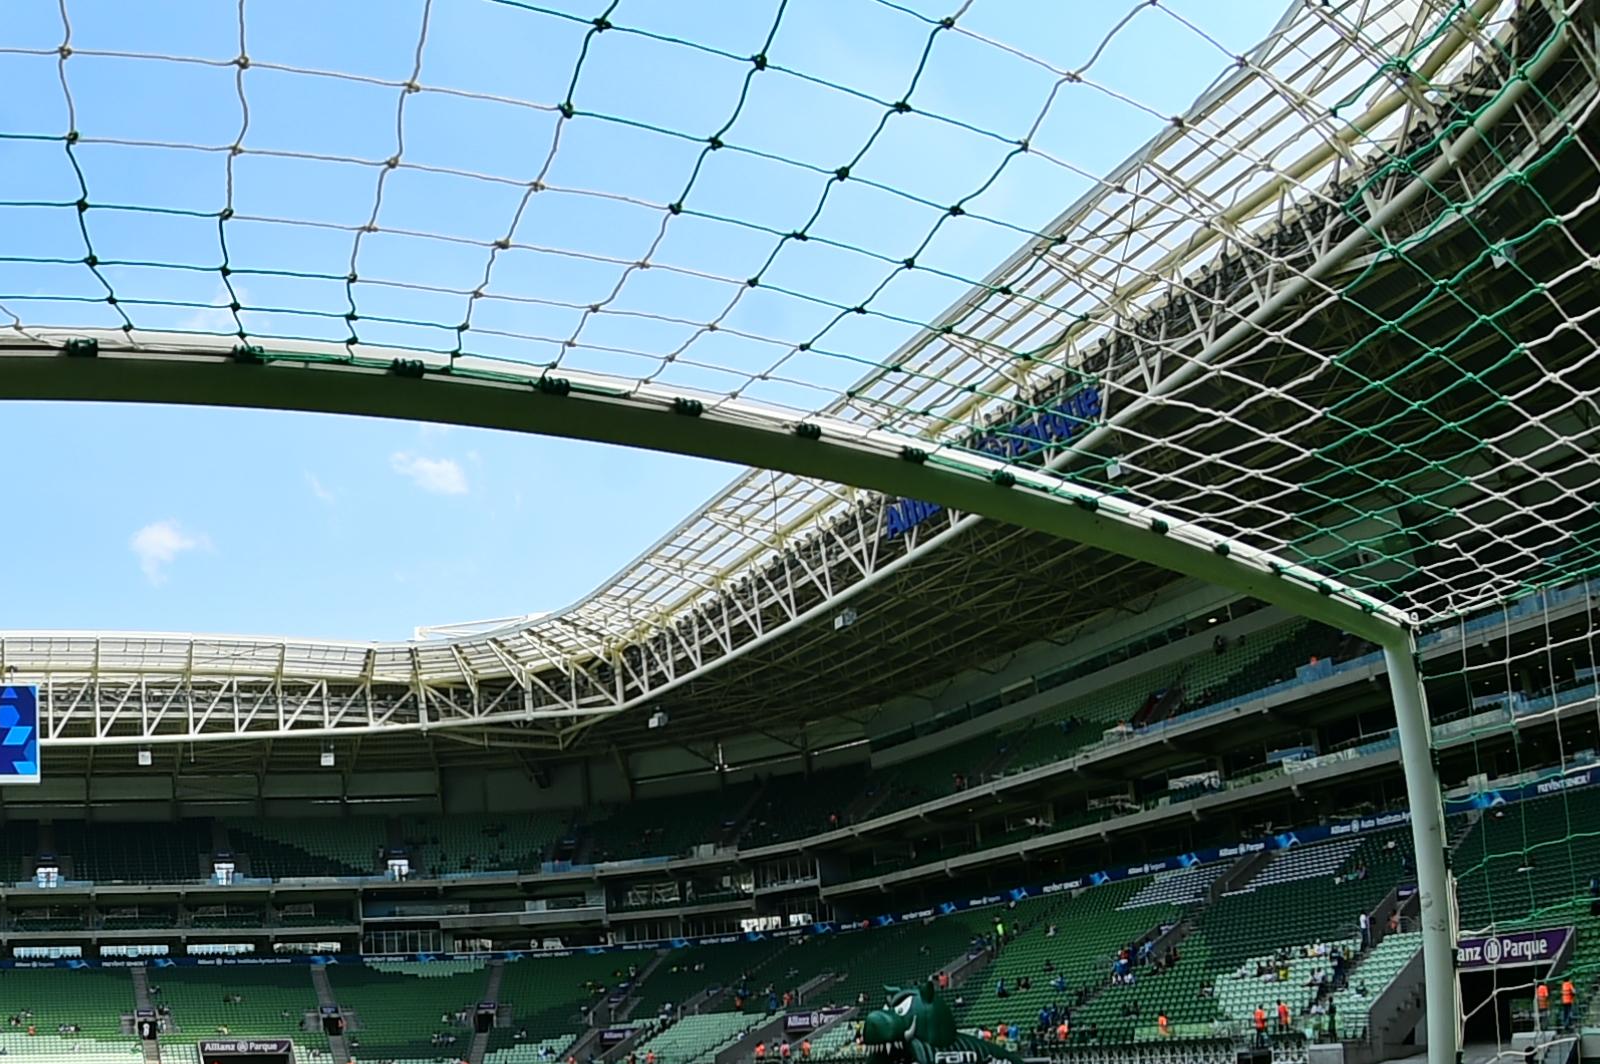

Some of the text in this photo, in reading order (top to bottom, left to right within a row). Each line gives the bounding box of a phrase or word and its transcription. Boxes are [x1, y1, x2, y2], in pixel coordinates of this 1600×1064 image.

[1503, 938, 1548, 961] Parque
[205, 1042, 278, 1053] Allianz Parque
